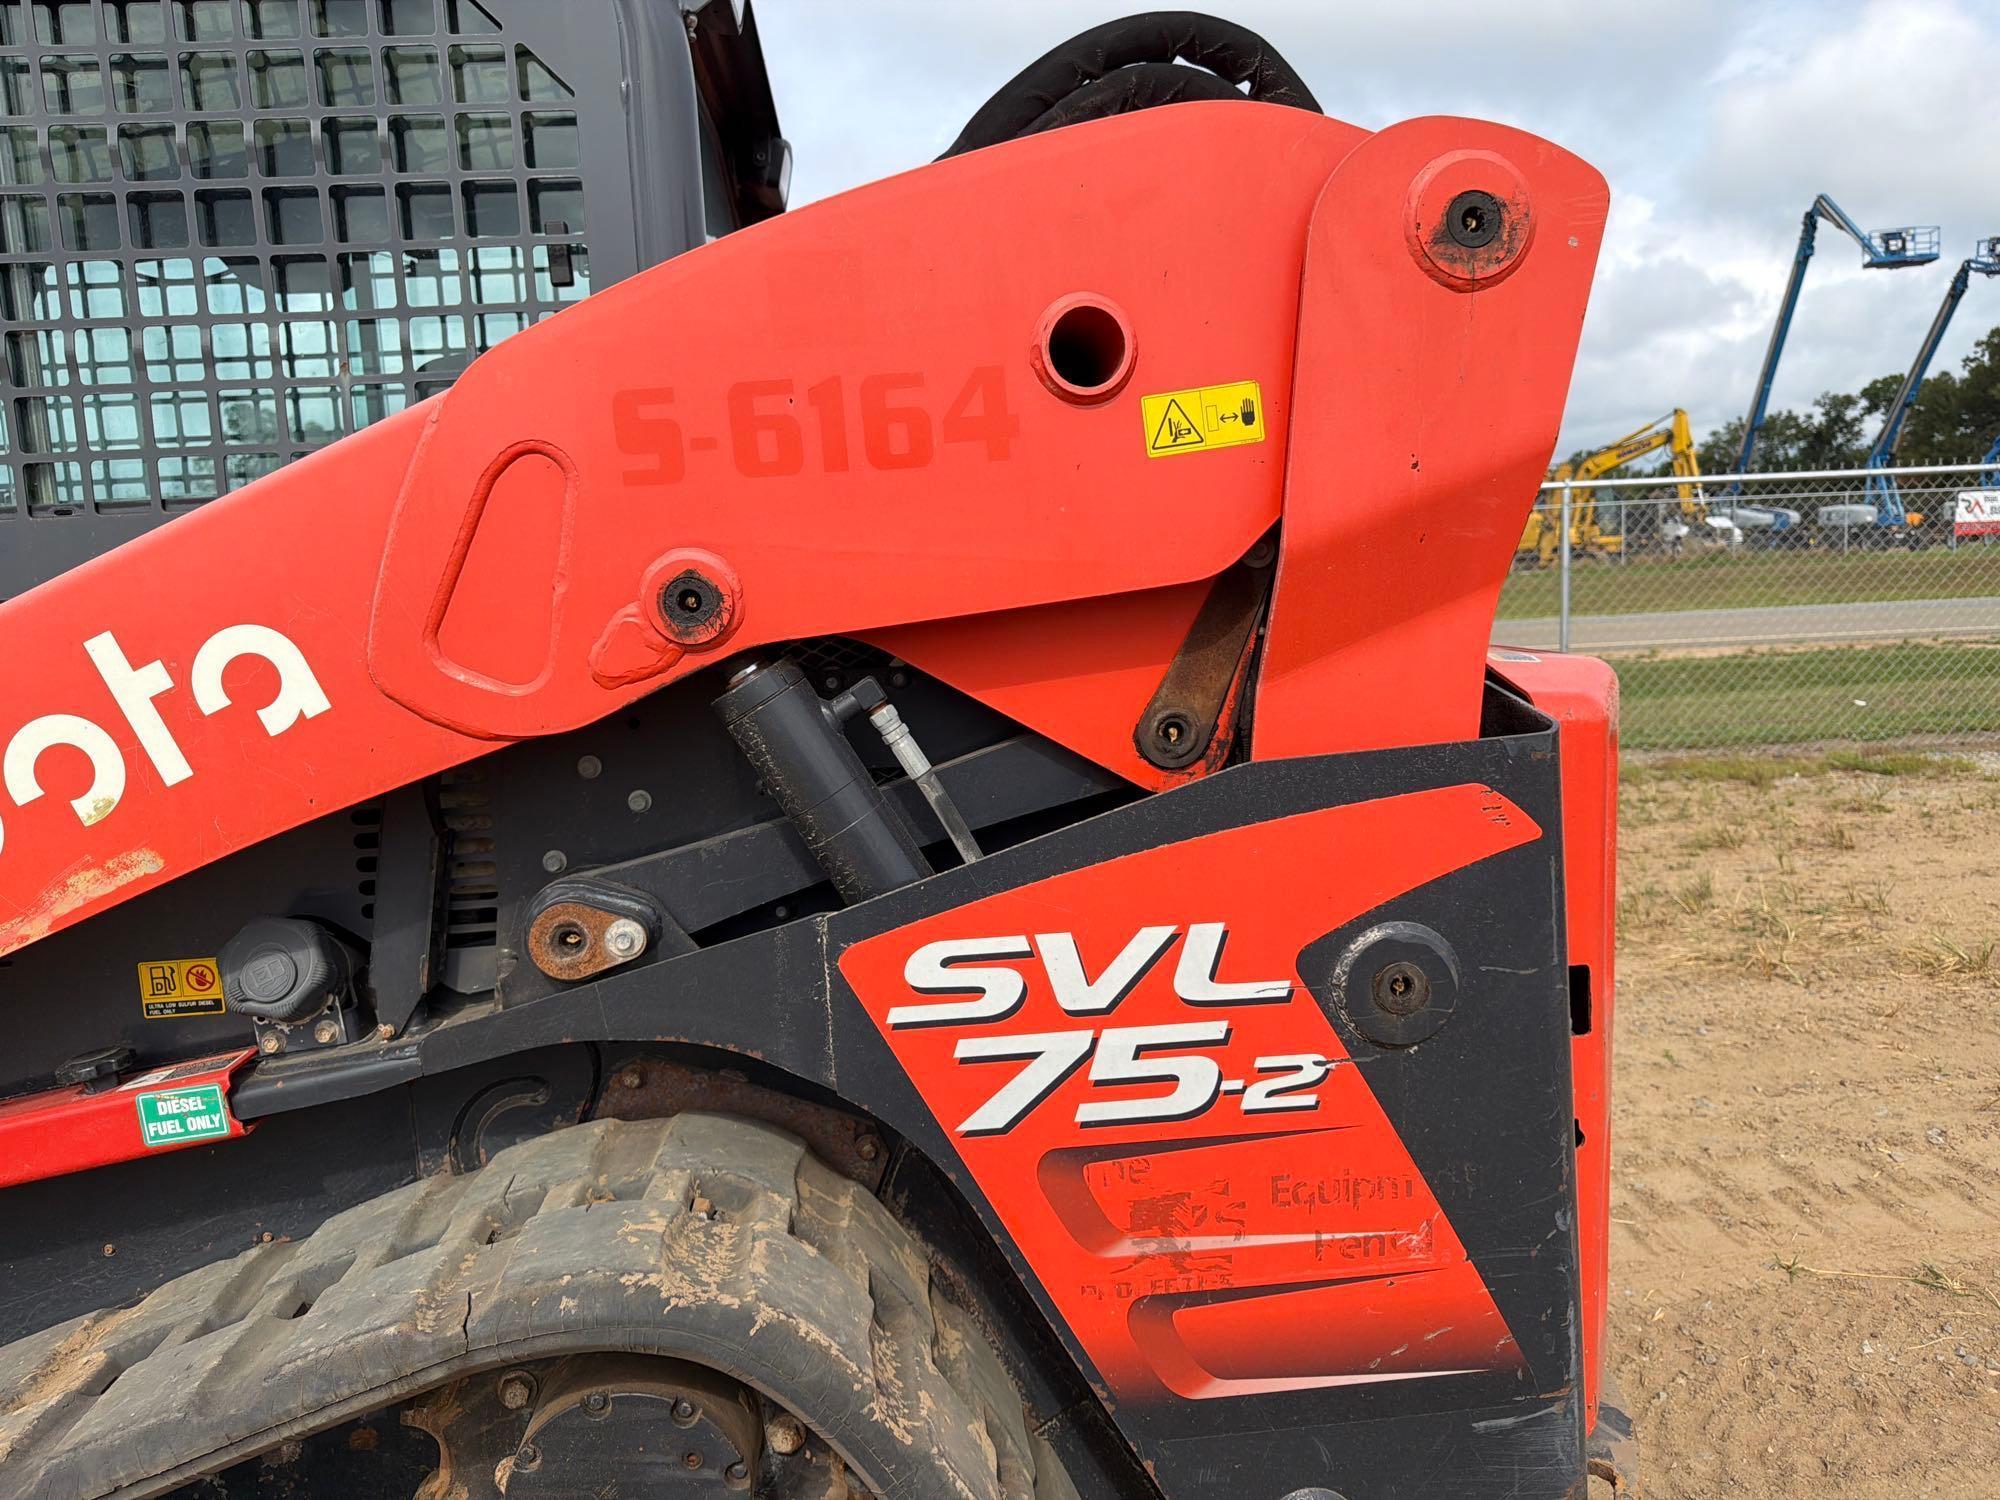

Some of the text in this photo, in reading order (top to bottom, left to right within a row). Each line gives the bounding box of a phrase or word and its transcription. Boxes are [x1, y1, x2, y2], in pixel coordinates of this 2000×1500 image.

[612, 365, 1020, 487] S-6164
[886, 922, 1295, 1030] SVL
[148, 1113, 221, 1137] FUEL ONLY
[156, 1096, 206, 1116] DIESEL
[953, 1020, 1330, 1137] 75-2
